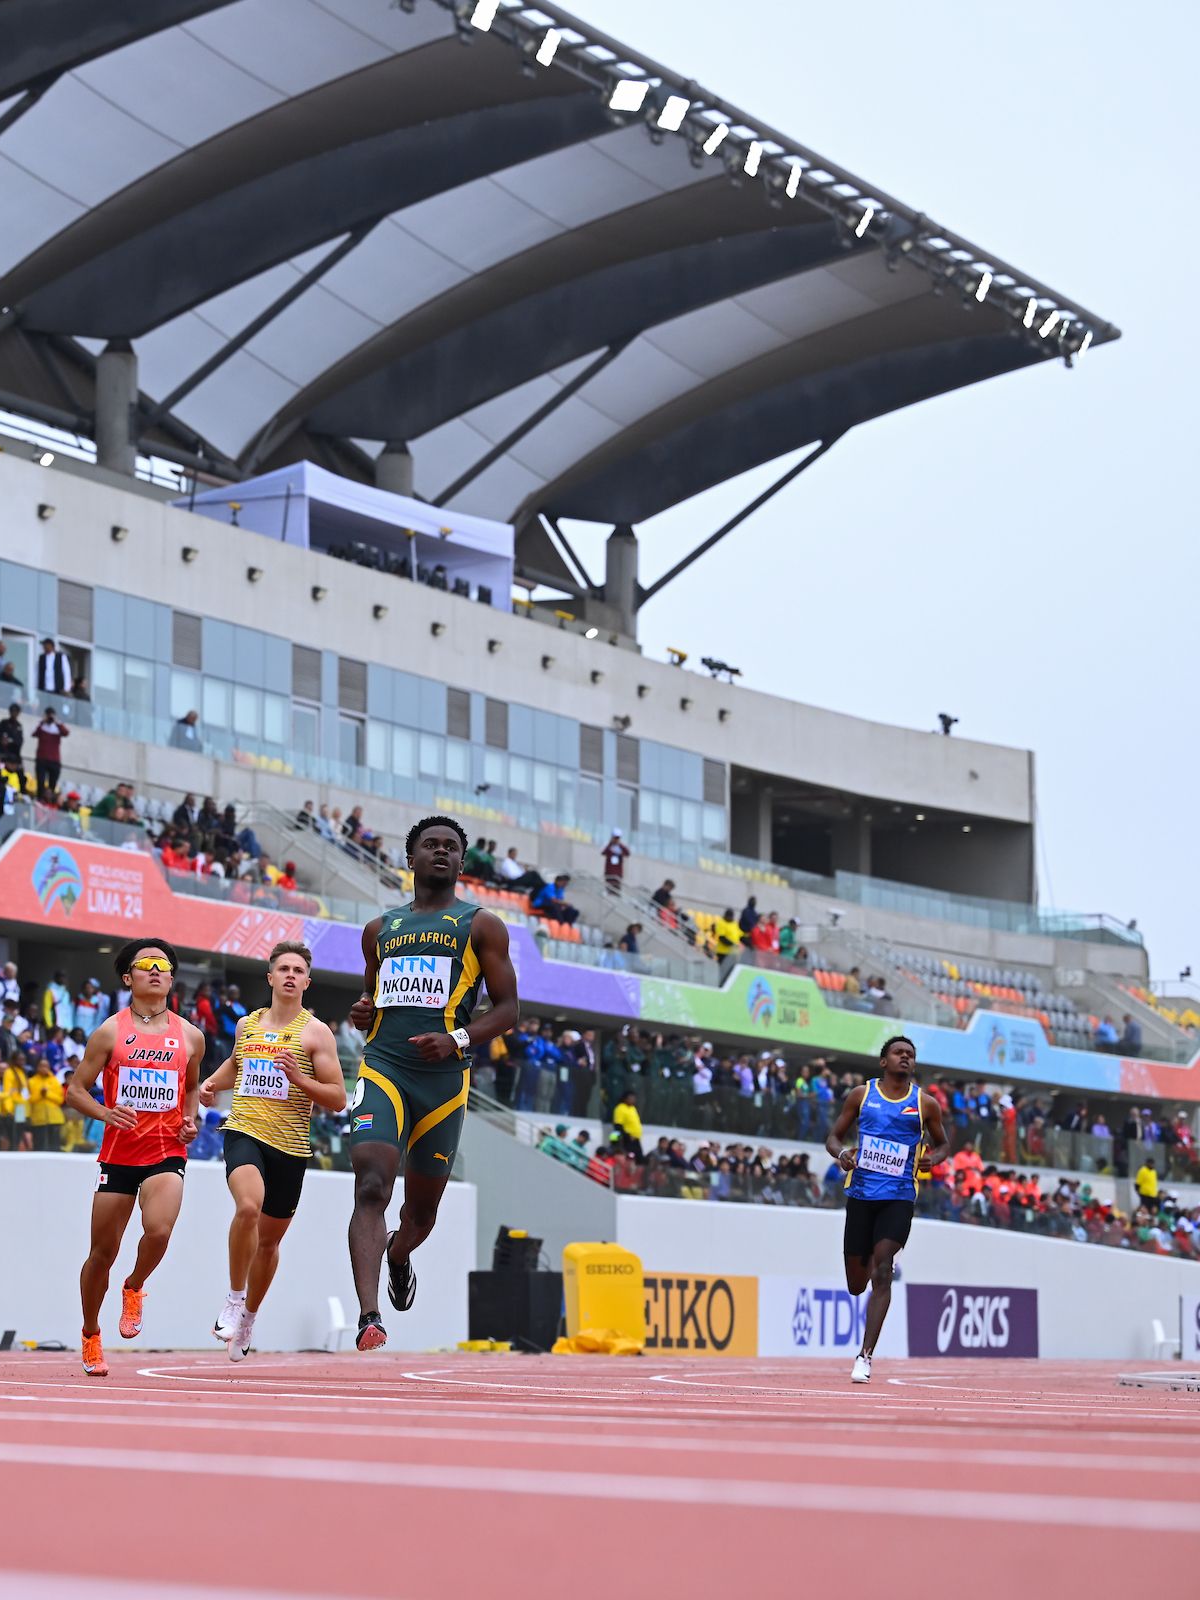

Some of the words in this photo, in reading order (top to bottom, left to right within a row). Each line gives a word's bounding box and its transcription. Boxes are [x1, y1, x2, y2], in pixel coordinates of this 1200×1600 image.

[88, 888, 121, 917] LIMA
[123, 894, 143, 919] 24
[384, 933, 415, 953] SOUTH
[419, 932, 457, 949] AFRICA
[391, 957, 435, 974] NTN
[382, 977, 444, 995] NKOANA
[397, 995, 422, 1004] LIMA
[426, 996, 440, 1005] 24
[128, 1048, 174, 1062] JAPAN
[248, 1059, 280, 1073] NTN
[129, 1069, 167, 1084] NTN
[245, 1074, 283, 1088] ZIRBUS
[121, 1085, 174, 1101] KOMURO
[136, 1101, 157, 1109] LIMA
[870, 1138, 900, 1154] NTN
[863, 1149, 904, 1167] BARREAU
[872, 1164, 888, 1172] LIMA
[585, 1263, 634, 1275] SEIKO
[644, 1278, 735, 1351] EIKO
[959, 1294, 1011, 1348] asics
